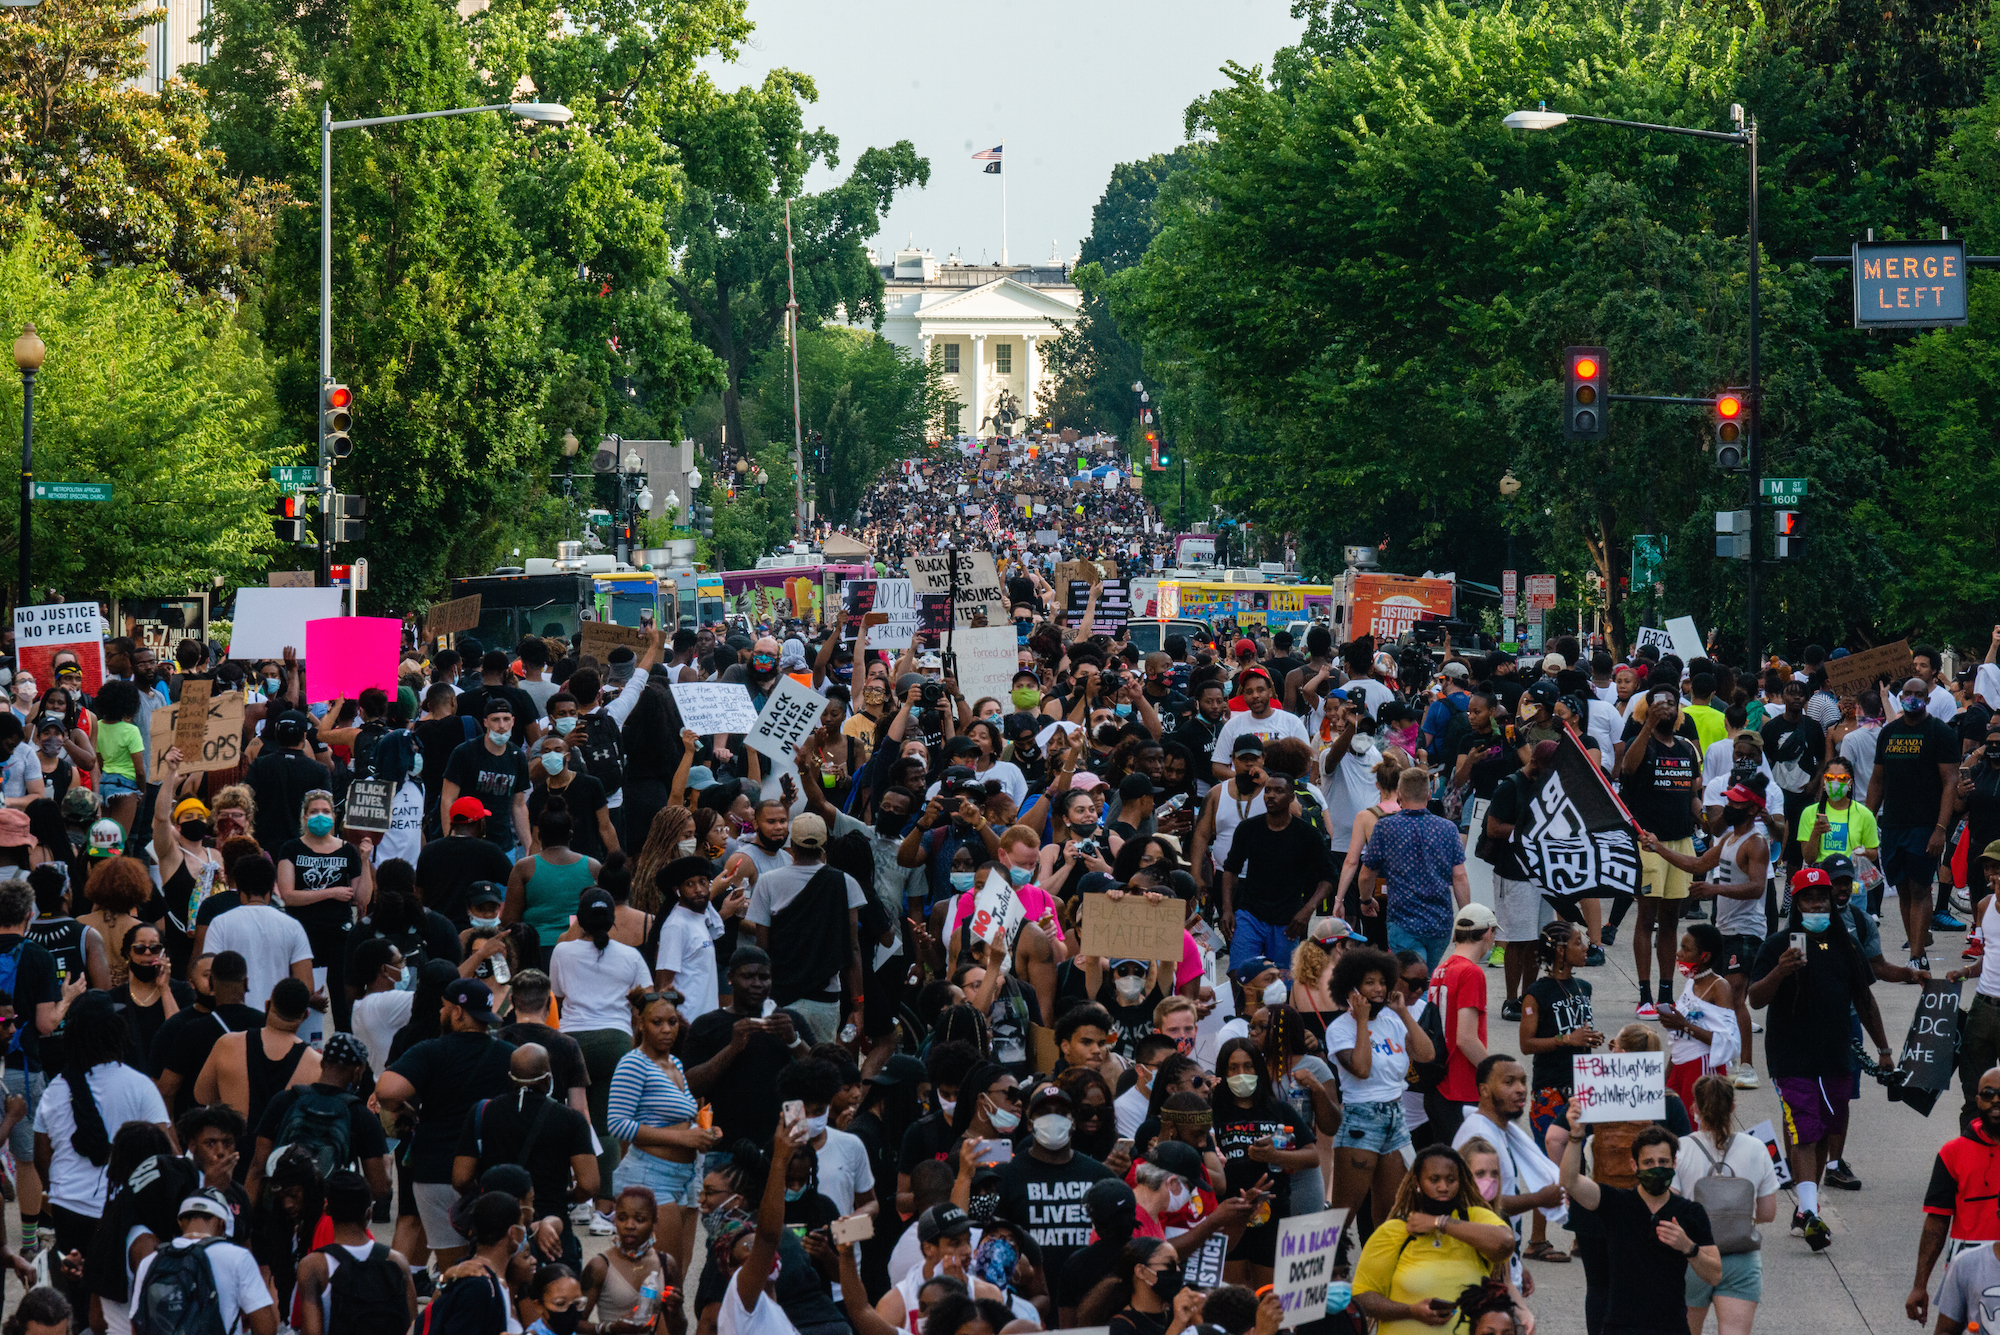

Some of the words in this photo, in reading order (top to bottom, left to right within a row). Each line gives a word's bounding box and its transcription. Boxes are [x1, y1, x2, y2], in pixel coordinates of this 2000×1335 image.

[1864, 256, 1957, 280] MERGE
[1879, 286, 1945, 309] LEFT
[280, 469, 293, 481] M
[283, 482, 306, 491] 1500
[1771, 481, 1784, 494] M
[1772, 495, 1798, 504] 1600
[914, 558, 948, 573] BLACK
[976, 586, 1002, 601] LIVES
[17, 610, 35, 623] NO
[40, 606, 96, 622] JUSTICE
[1381, 605, 1422, 621] DISTRICT
[24, 625, 42, 638] NO
[48, 621, 92, 636] PEACE
[591, 625, 624, 640] George
[878, 625, 916, 640] BREONN
[1370, 617, 1414, 639] FALAF
[143, 624, 169, 646] 5.7
[169, 628, 201, 640] MILLION
[973, 647, 999, 658] forced
[1000, 645, 1017, 658] out
[1879, 647, 1898, 657] BEEN
[968, 662, 985, 672] sat
[961, 676, 980, 685] was
[674, 685, 689, 697] IF
[695, 685, 713, 694] the
[716, 685, 748, 696] POLICE
[679, 696, 697, 705] didn't
[700, 694, 717, 702] treat
[718, 702, 739, 710] TRUST
[683, 711, 713, 722] Nobody's
[759, 692, 793, 737] BLACK
[689, 721, 704, 729] song
[772, 702, 801, 740] LIVES
[724, 722, 747, 733] Dept
[780, 701, 819, 756] MATTER
[1887, 738, 1923, 747] WAKANDA
[1885, 745, 1921, 754] FOREVER
[1655, 759, 1660, 767] I
[1660, 759, 1679, 767] LOVE
[1654, 769, 1693, 777] BLACKNESS
[1653, 779, 1672, 787] AND
[355, 783, 387, 796] BLACK.
[356, 795, 384, 807] LIVES.
[403, 793, 409, 803] I
[349, 806, 388, 820] MATTER.
[392, 806, 419, 817] CAN'T
[390, 820, 423, 830] REATH
[94, 833, 118, 843] BABY
[1825, 831, 1833, 840] IS
[1825, 840, 1845, 850] DOPE.
[323, 856, 348, 868] MUTE
[1088, 901, 1139, 922] BLACK
[1145, 907, 1182, 925] LIVES
[972, 909, 992, 939] NO
[1092, 922, 1170, 949] MATTER
[1225, 1123, 1256, 1132] LOVE
[1259, 1123, 1277, 1132] MY
[1027, 1181, 1093, 1201] BLACK
[1028, 1204, 1092, 1224] LIVES
[1281, 1230, 1296, 1258] I'M
[1298, 1233, 1306, 1255] A
[1309, 1225, 1340, 1253] BLACK
[1289, 1254, 1326, 1284] DOCTOR
[1294, 1290, 1303, 1310] A
[1303, 1282, 1328, 1308] THUG
